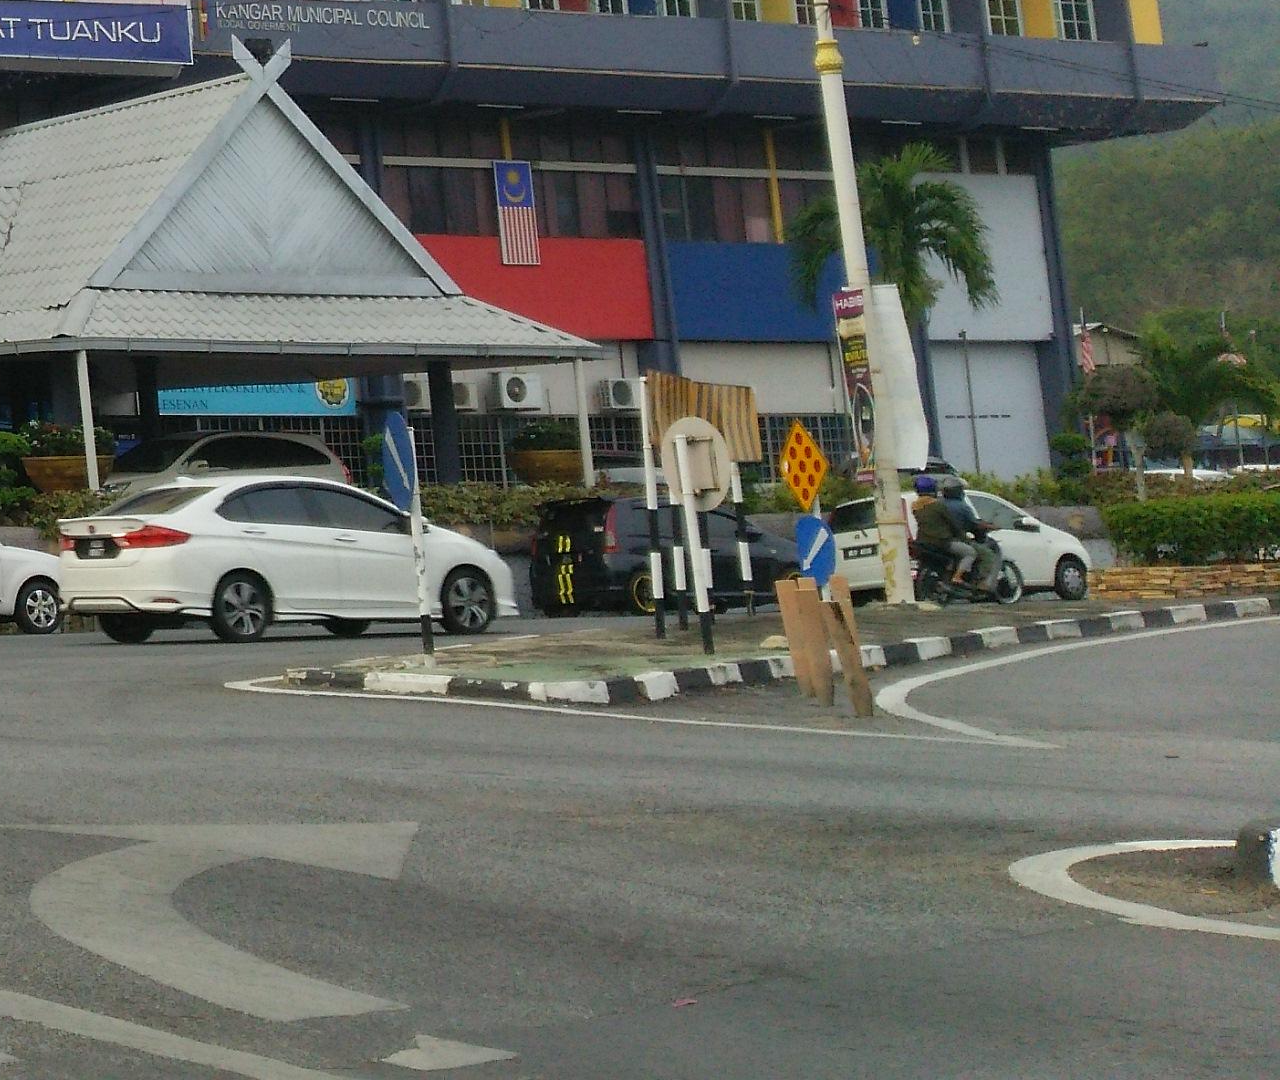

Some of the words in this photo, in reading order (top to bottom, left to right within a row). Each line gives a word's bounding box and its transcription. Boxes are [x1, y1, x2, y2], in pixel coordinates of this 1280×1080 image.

[215, 1, 284, 22] KANGAR
[288, 5, 362, 27] MUNICIPAL
[366, 9, 430, 29] COUNCIL
[28, 18, 161, 44] TUANKU
[162, 399, 209, 410] ESENAN
